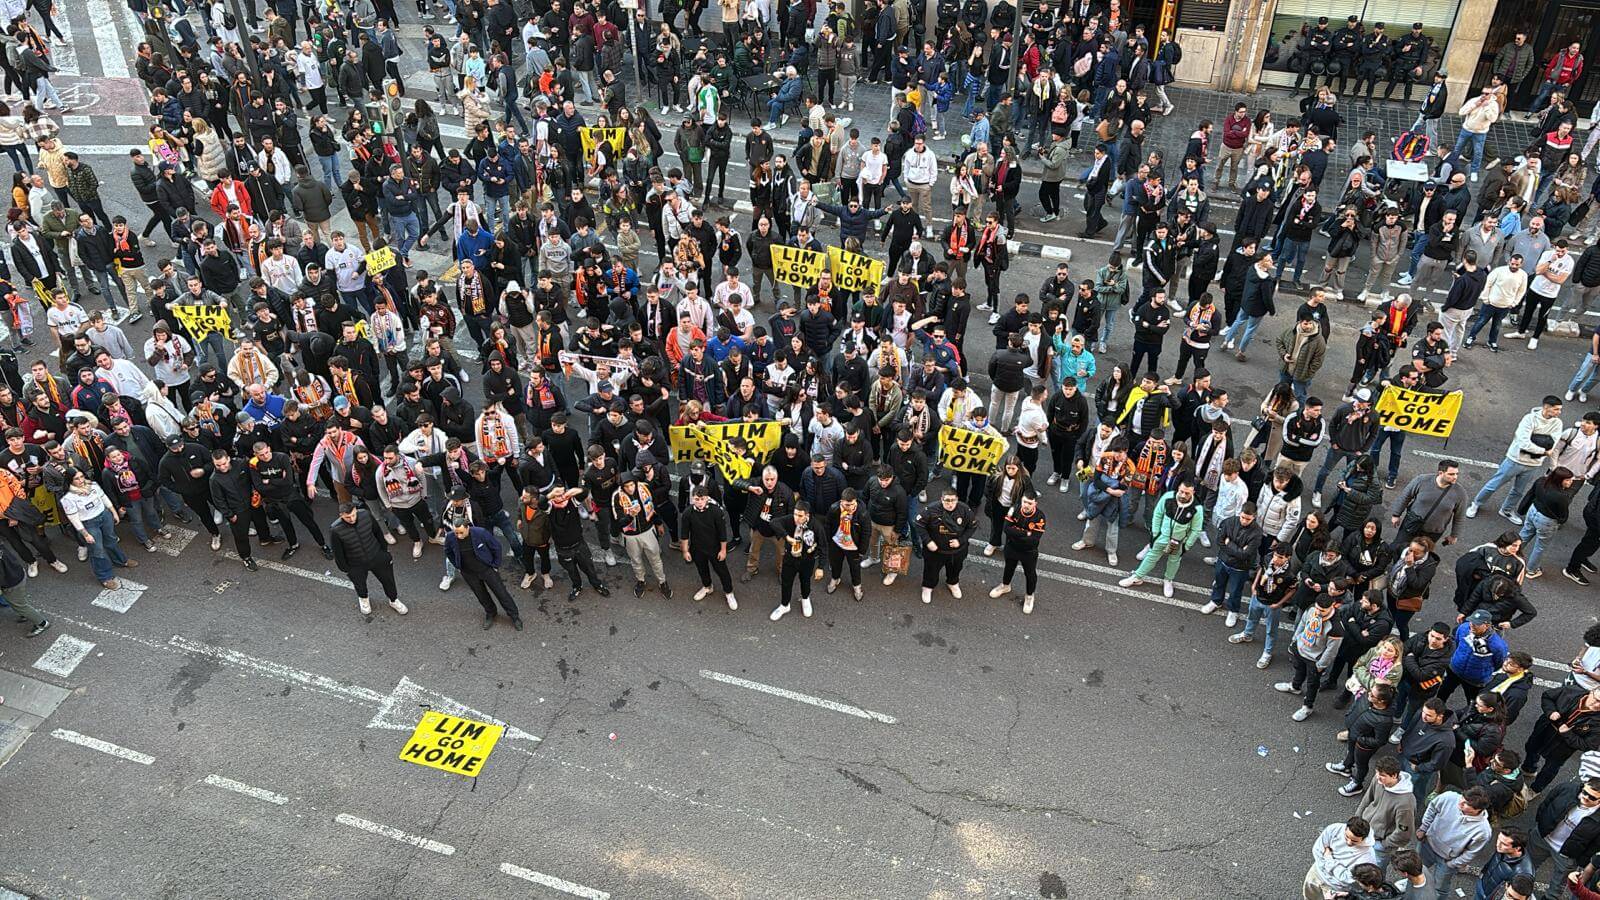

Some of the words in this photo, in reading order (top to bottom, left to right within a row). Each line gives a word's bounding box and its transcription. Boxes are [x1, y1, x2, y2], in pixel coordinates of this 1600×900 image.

[371, 249, 386, 261] LIM
[783, 248, 817, 265] LIM
[840, 251, 873, 269] LIM
[791, 263, 809, 274] GO
[846, 267, 863, 276] GO
[181, 306, 222, 317] LIM
[1397, 391, 1449, 406] LIM
[1404, 403, 1430, 415] GO
[1380, 410, 1451, 433] HOME
[722, 423, 768, 441] LIM
[948, 429, 994, 450] LIM
[957, 445, 981, 456] GO
[434, 718, 486, 740] LIM
[438, 737, 465, 749] GO
[405, 744, 482, 772] HOME
